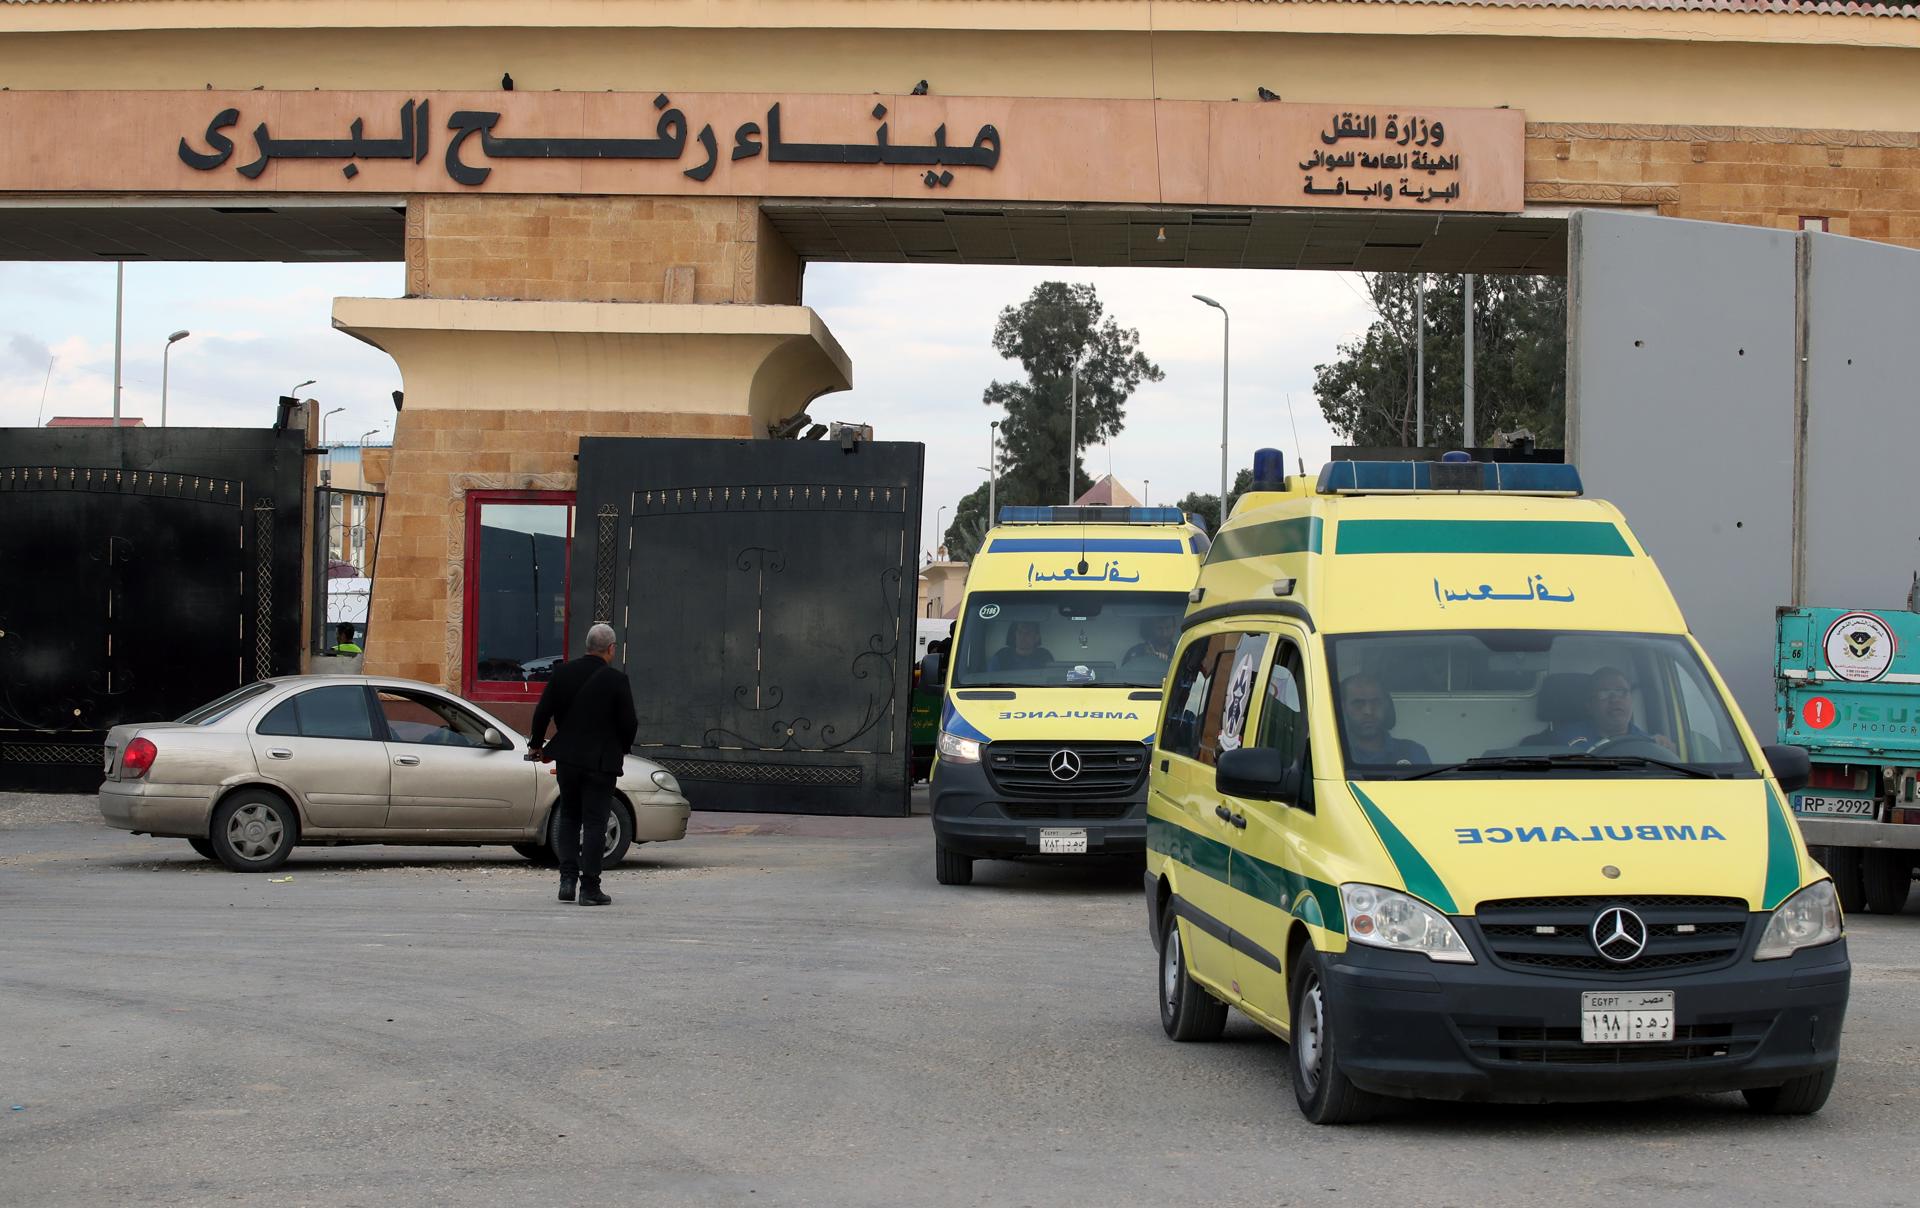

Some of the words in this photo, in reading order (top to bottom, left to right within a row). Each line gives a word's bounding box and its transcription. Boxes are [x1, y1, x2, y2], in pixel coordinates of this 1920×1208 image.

[446, 93, 718, 186] رفح
[1321, 111, 1377, 145] النقل
[1385, 113, 1445, 147] وزارة
[731, 101, 1001, 188] ميناء
[1358, 151, 1408, 170] العامة
[1411, 150, 1459, 175] الهيئة
[1303, 175, 1394, 201] والجافة
[1399, 177, 1460, 203] البرية
[1591, 998, 1619, 1007] EGYPT
[1639, 997, 1664, 1006] مصر
